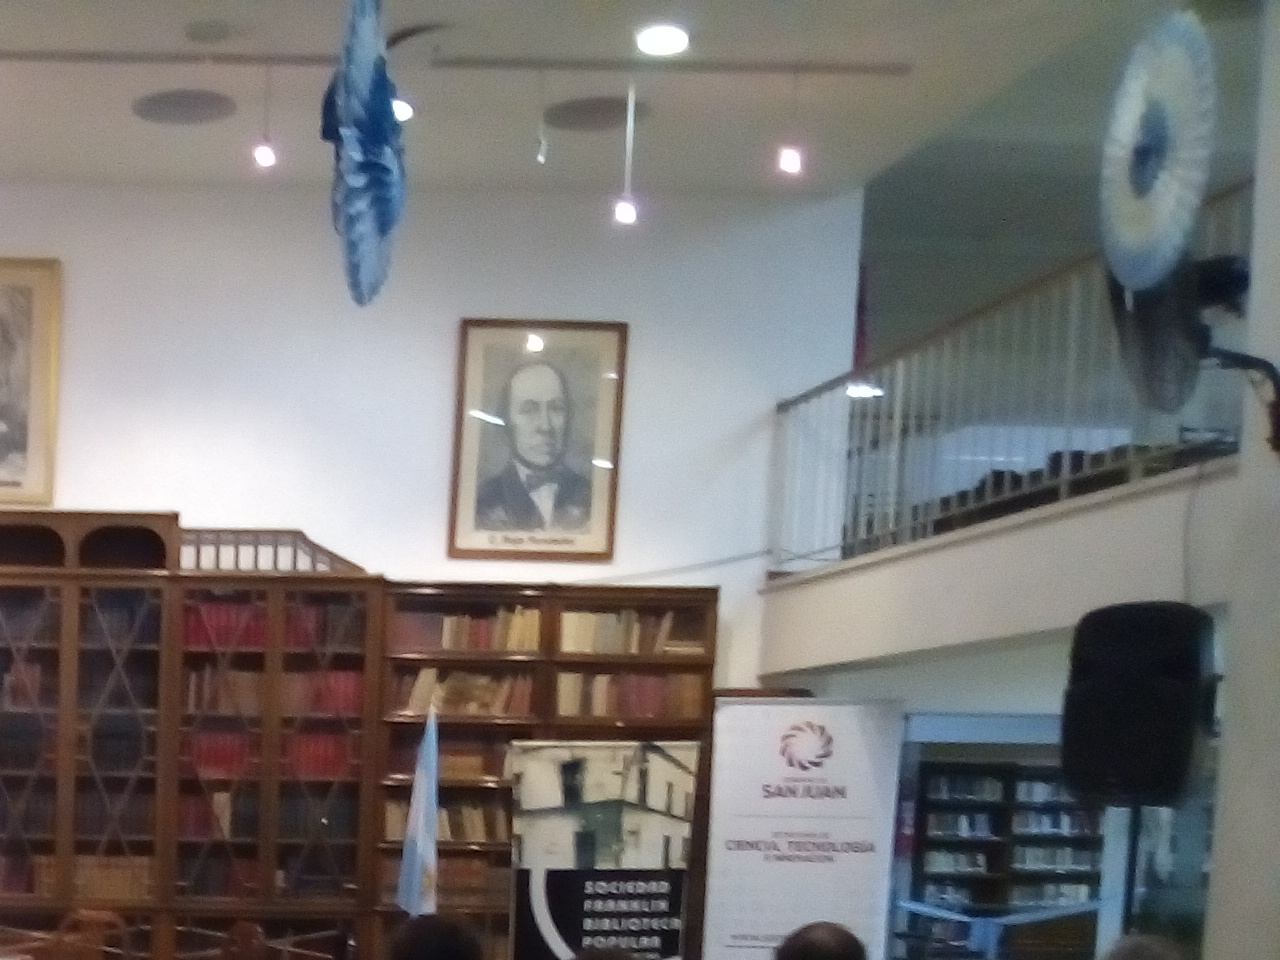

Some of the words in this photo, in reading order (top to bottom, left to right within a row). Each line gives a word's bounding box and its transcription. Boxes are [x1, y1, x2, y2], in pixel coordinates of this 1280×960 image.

[762, 784, 798, 799] SAN
[584, 881, 670, 895] SOCIEDAD
[583, 918, 681, 931] BIBLIOTECA
